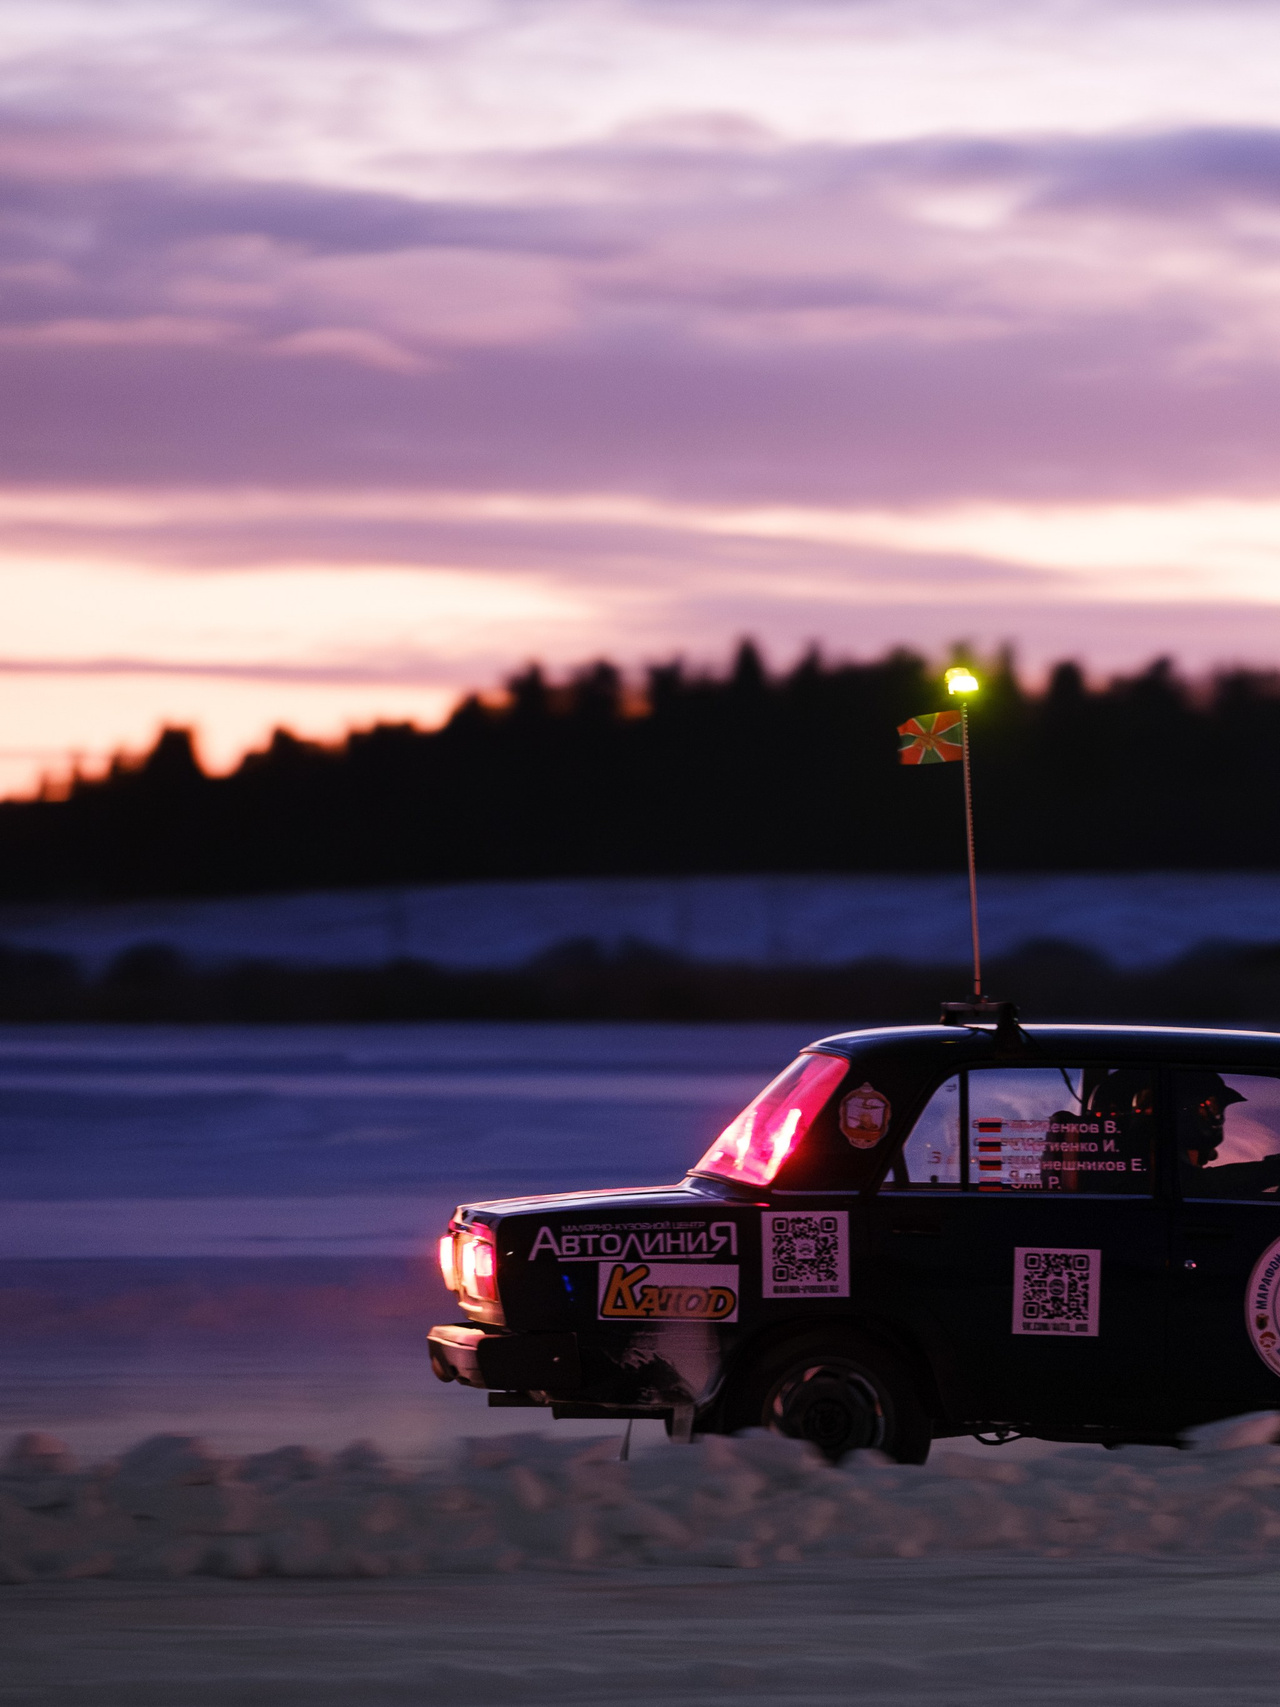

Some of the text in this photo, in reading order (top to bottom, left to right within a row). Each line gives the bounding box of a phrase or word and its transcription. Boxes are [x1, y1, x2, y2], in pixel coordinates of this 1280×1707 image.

[1104, 1120, 1122, 1134] В.
[1103, 1139, 1120, 1153] И.
[1131, 1158, 1147, 1172] Е.
[1048, 1176, 1062, 1190] Р.
